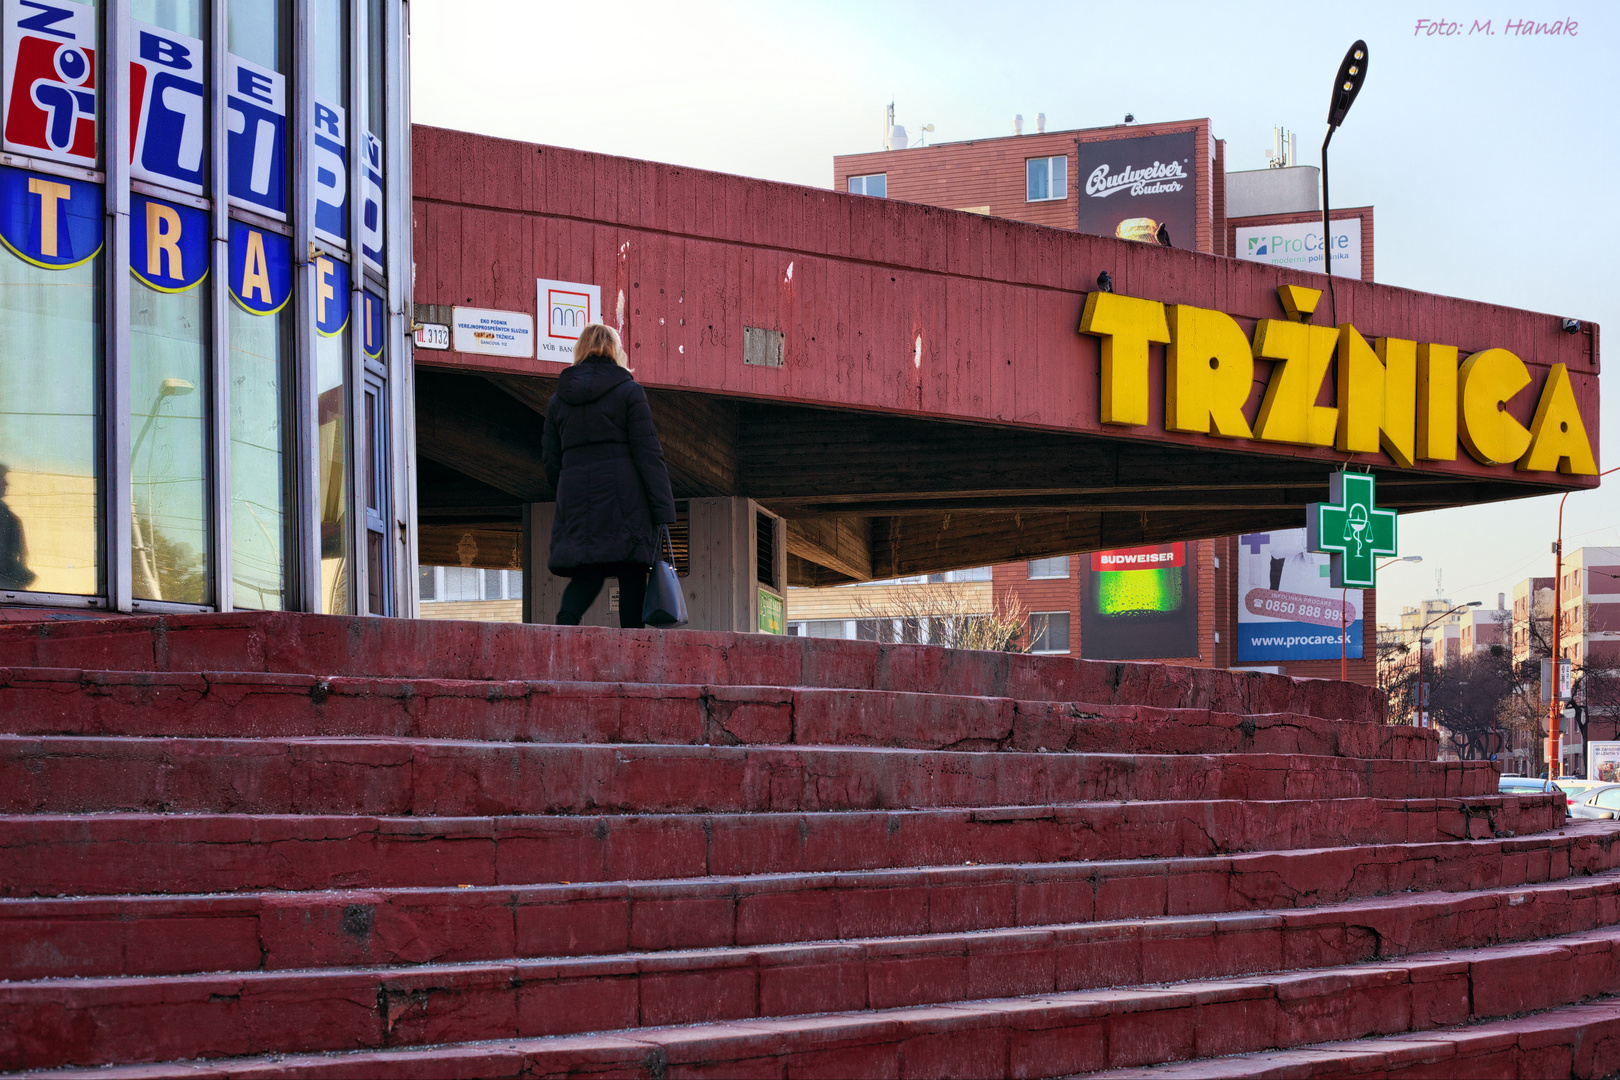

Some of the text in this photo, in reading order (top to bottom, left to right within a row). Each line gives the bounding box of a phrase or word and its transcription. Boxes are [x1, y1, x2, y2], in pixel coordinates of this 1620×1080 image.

[1085, 160, 1188, 197] Budweiser
[1130, 179, 1184, 196] Budvar
[1271, 233, 1349, 254] ProCare
[428, 328, 448, 345] 3132
[495, 332, 515, 340] TRŽNICA
[542, 343, 573, 353] VÚB BAN
[1078, 284, 1599, 476] TRŽNICA
[1100, 552, 1174, 564] BUDWEISER
[1271, 593, 1332, 607] INFOLINKA PROCARE
[1265, 600, 1347, 621] 0850 888 999
[1251, 632, 1352, 648] www.procare.sk
